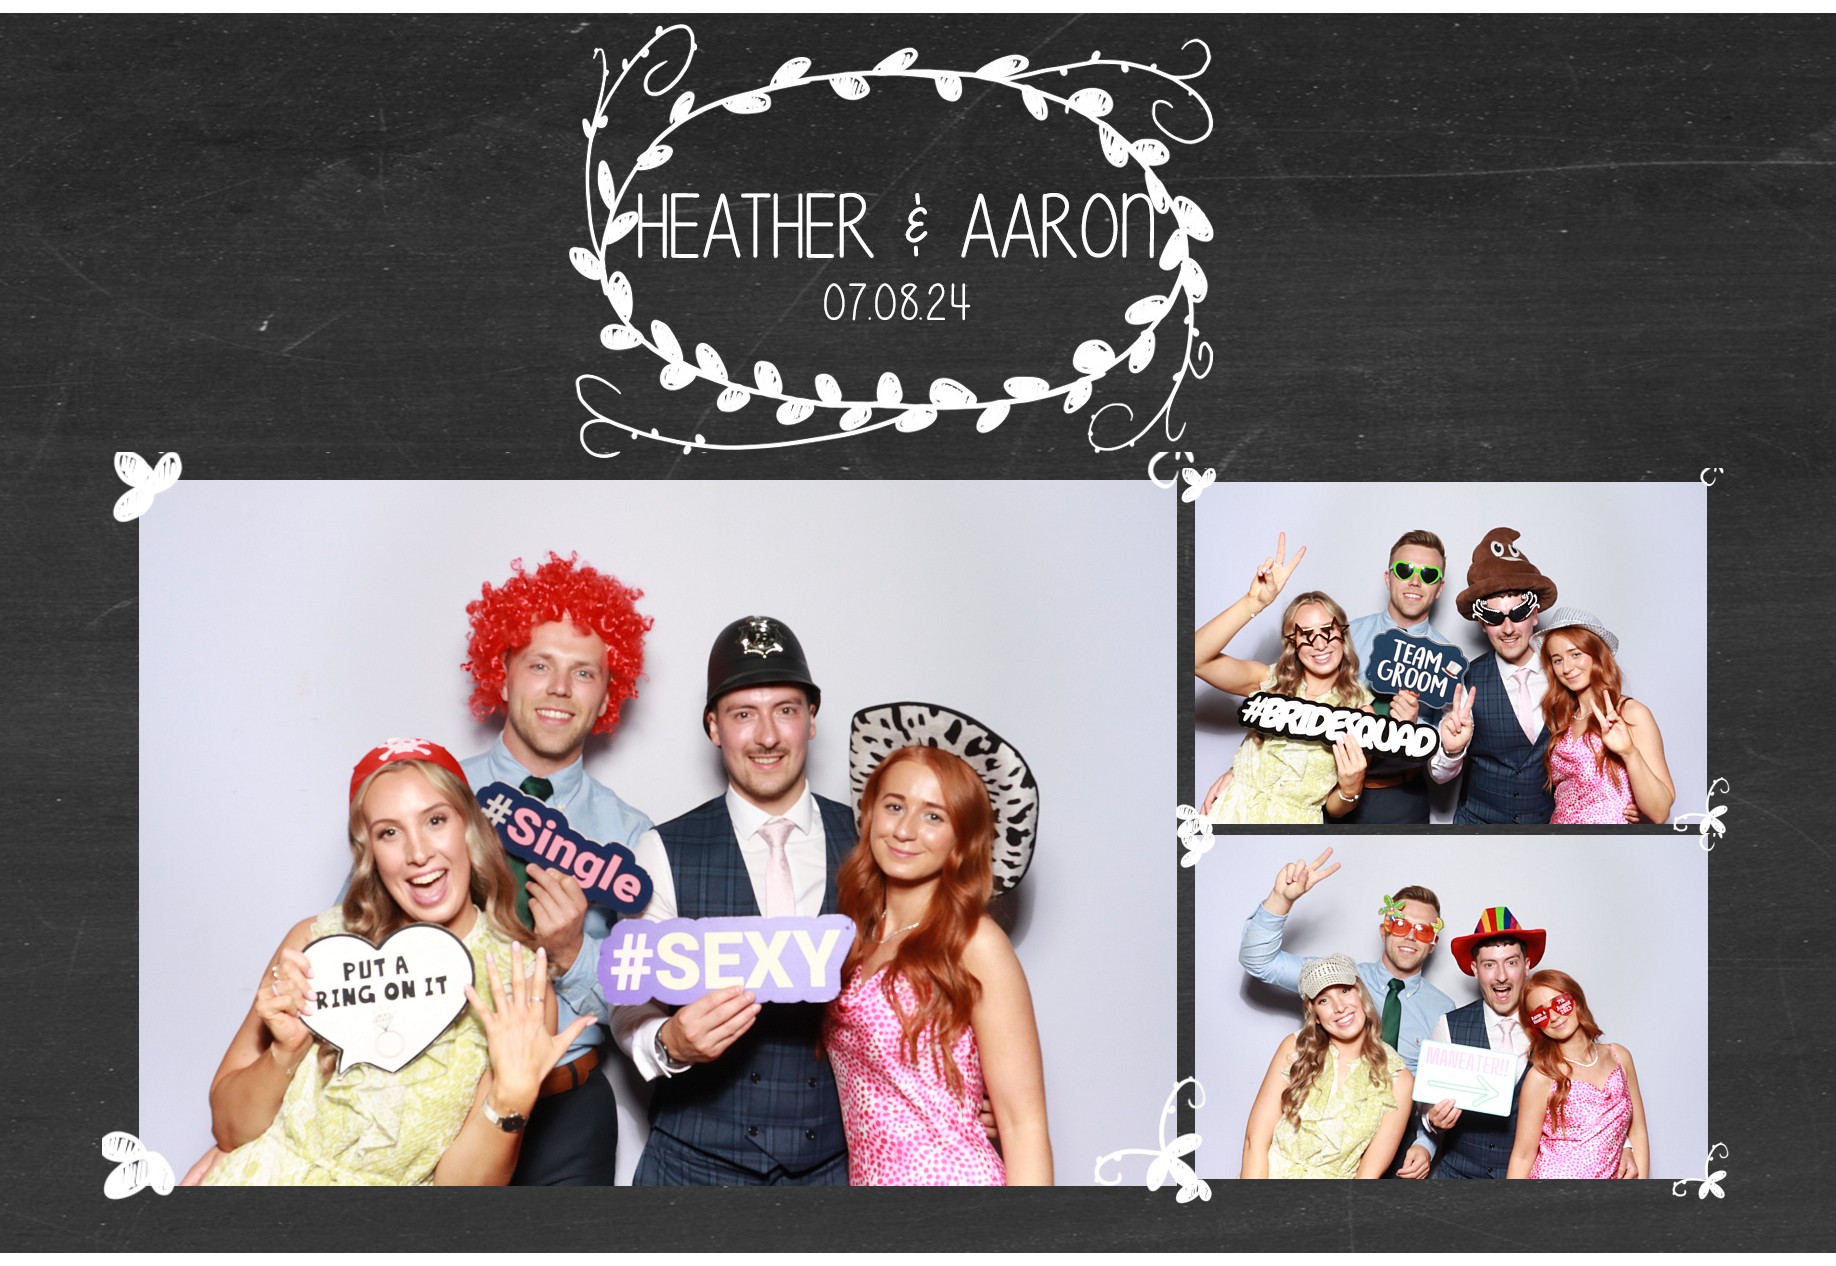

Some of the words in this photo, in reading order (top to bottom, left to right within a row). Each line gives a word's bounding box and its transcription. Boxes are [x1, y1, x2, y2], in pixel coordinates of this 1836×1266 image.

[1393, 638, 1443, 674] TEAM
[1377, 660, 1449, 698] GROOM
[481, 793, 643, 903] #Single
[343, 957, 386, 982] PUT
[395, 955, 409, 975] A
[610, 929, 842, 991] #SEXY
[316, 985, 376, 1010] RING
[384, 980, 416, 1001] ON
[425, 975, 448, 997] IT
[1426, 1046, 1510, 1077] MANEATER!!
